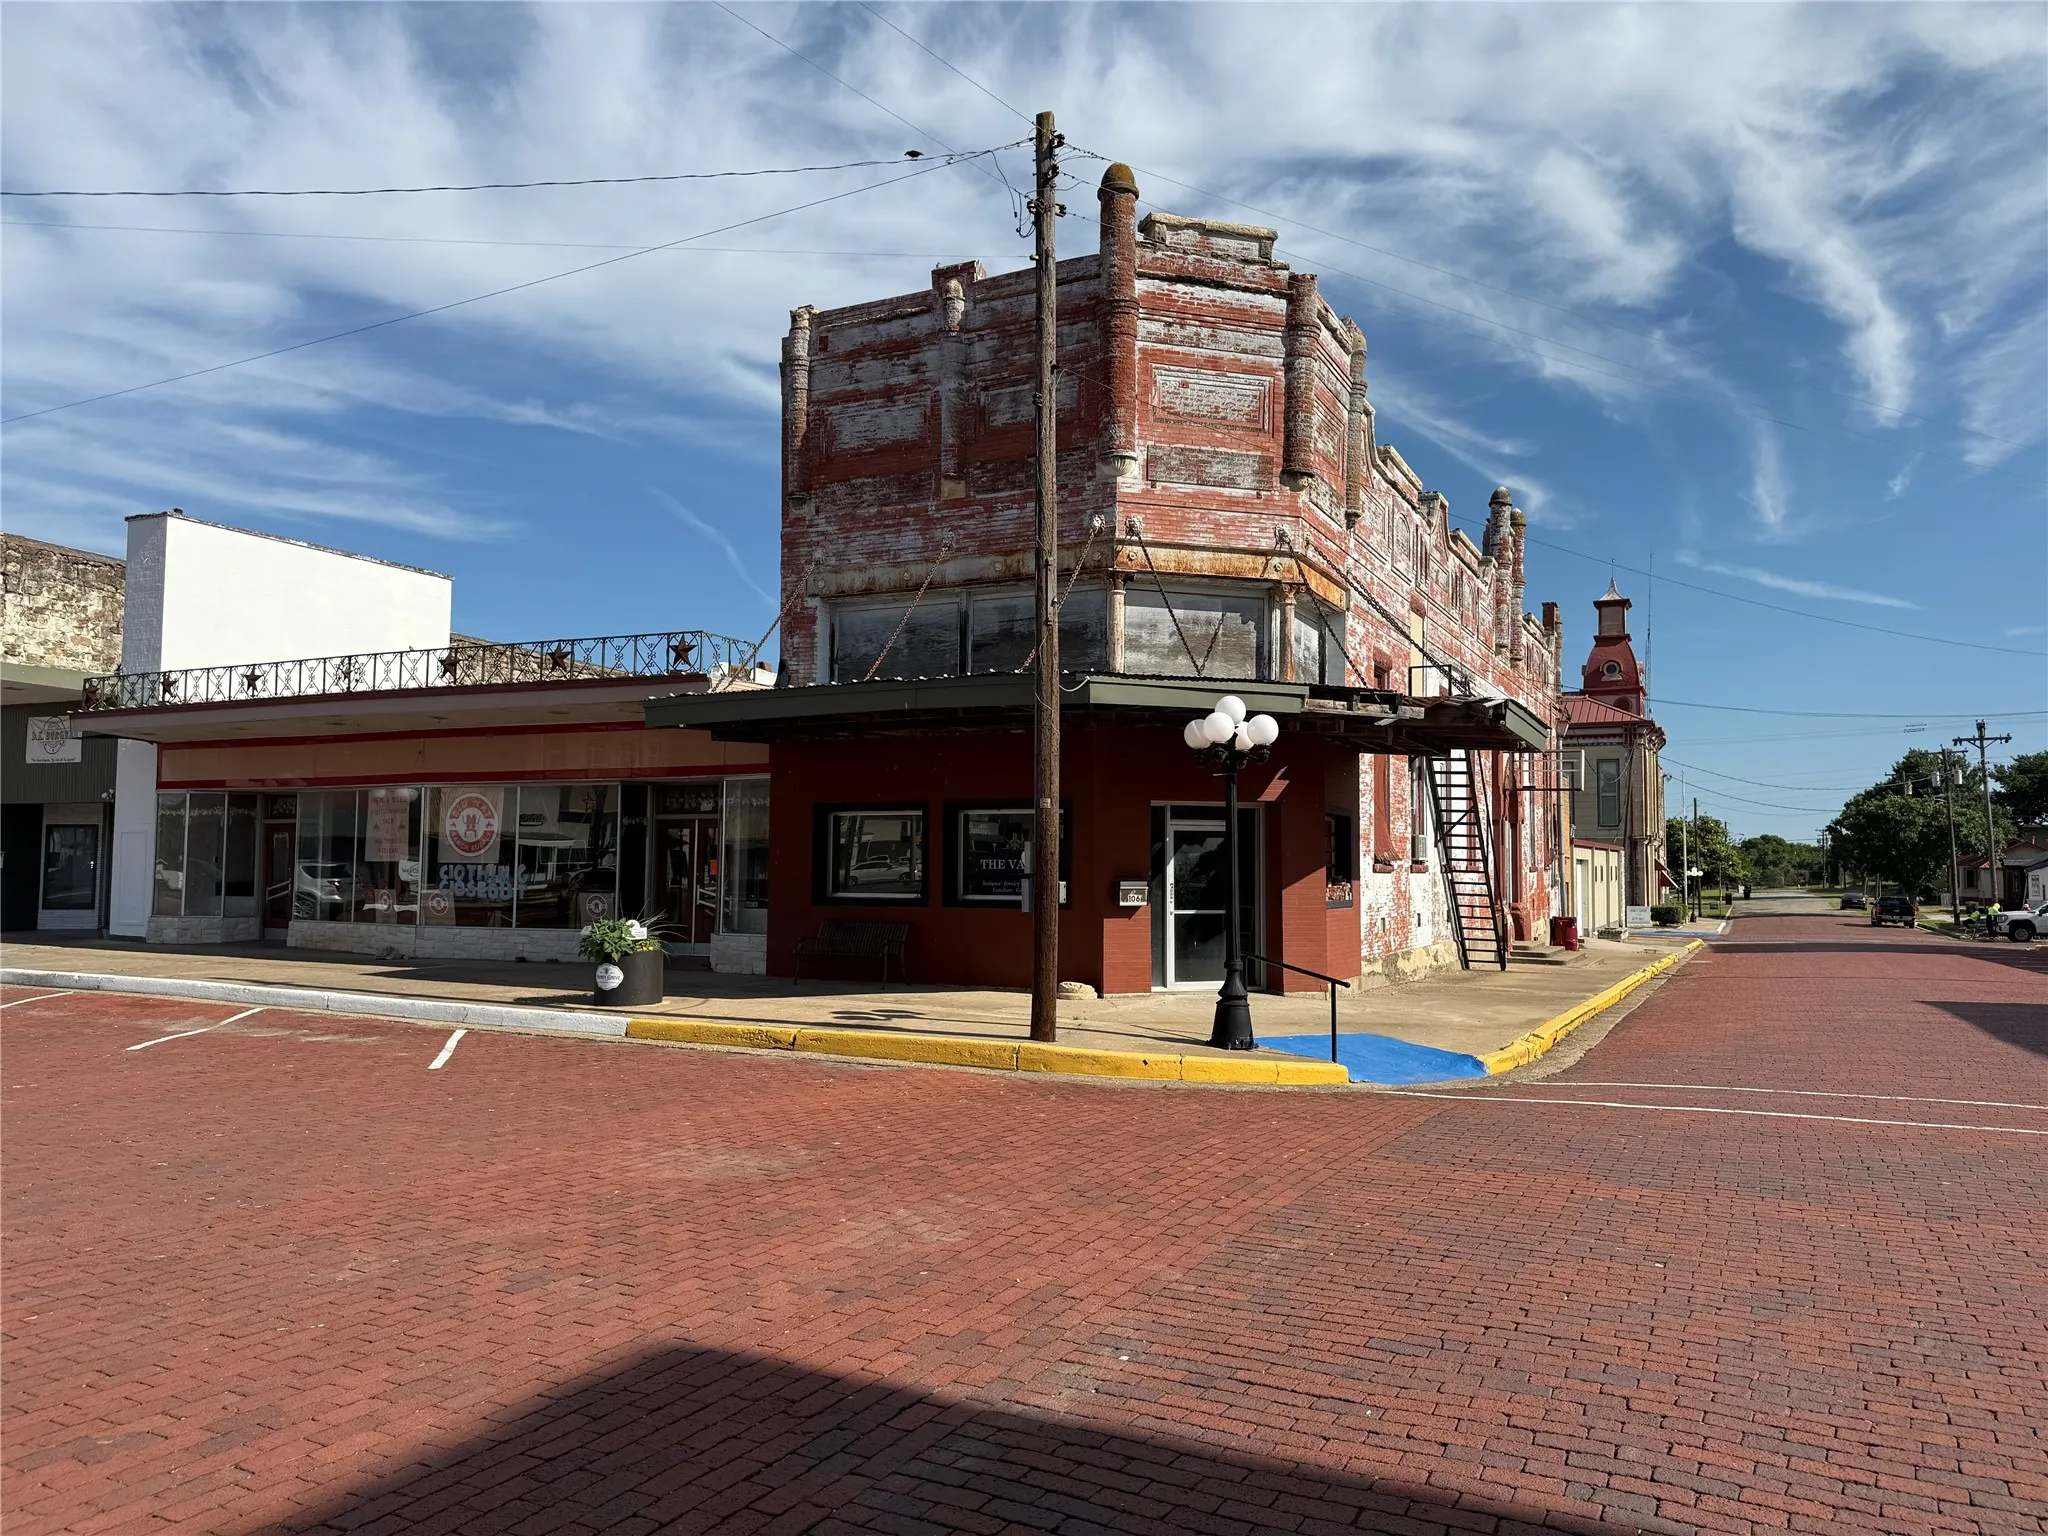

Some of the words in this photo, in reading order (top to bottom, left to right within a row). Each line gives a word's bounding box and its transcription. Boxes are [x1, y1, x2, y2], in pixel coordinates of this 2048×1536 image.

[980, 859, 1006, 870] THE
[1008, 859, 1025, 870] VA
[1128, 895, 1142, 903] 106
